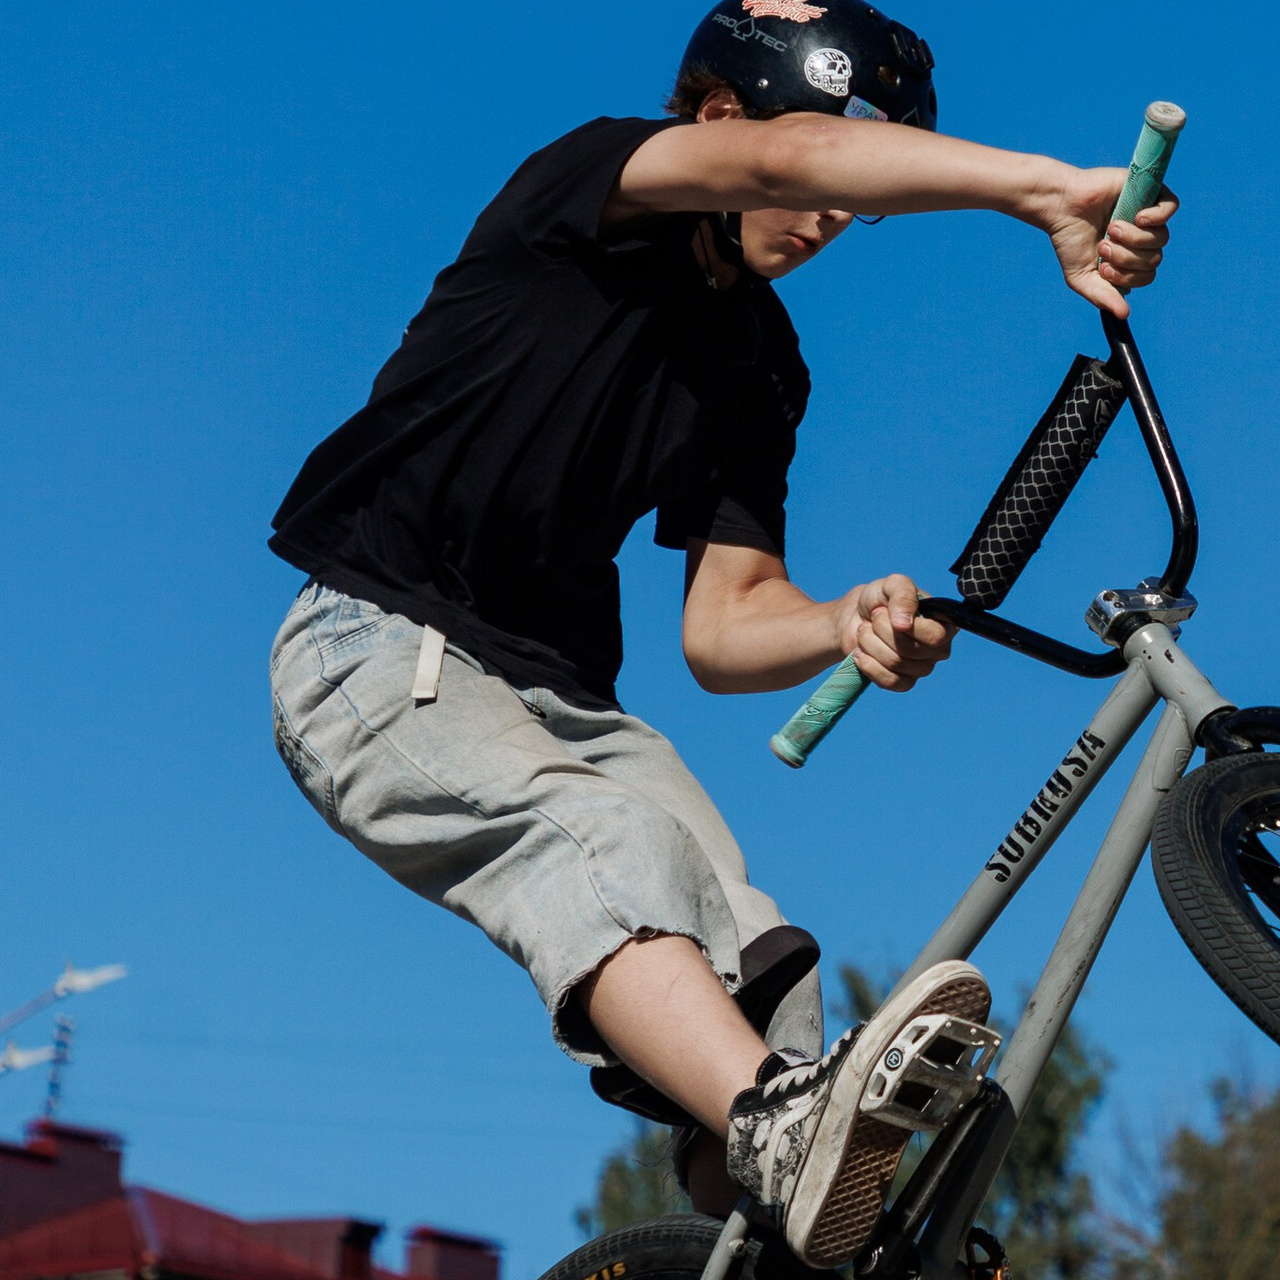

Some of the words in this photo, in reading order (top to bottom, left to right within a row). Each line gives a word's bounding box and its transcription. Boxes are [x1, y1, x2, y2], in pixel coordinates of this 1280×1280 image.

[711, 13, 735, 28] PRO
[754, 30, 787, 52] TEC
[808, 51, 846, 83] SKETON
[823, 77, 845, 93] BMX
[985, 728, 1107, 883] SUBROSA
